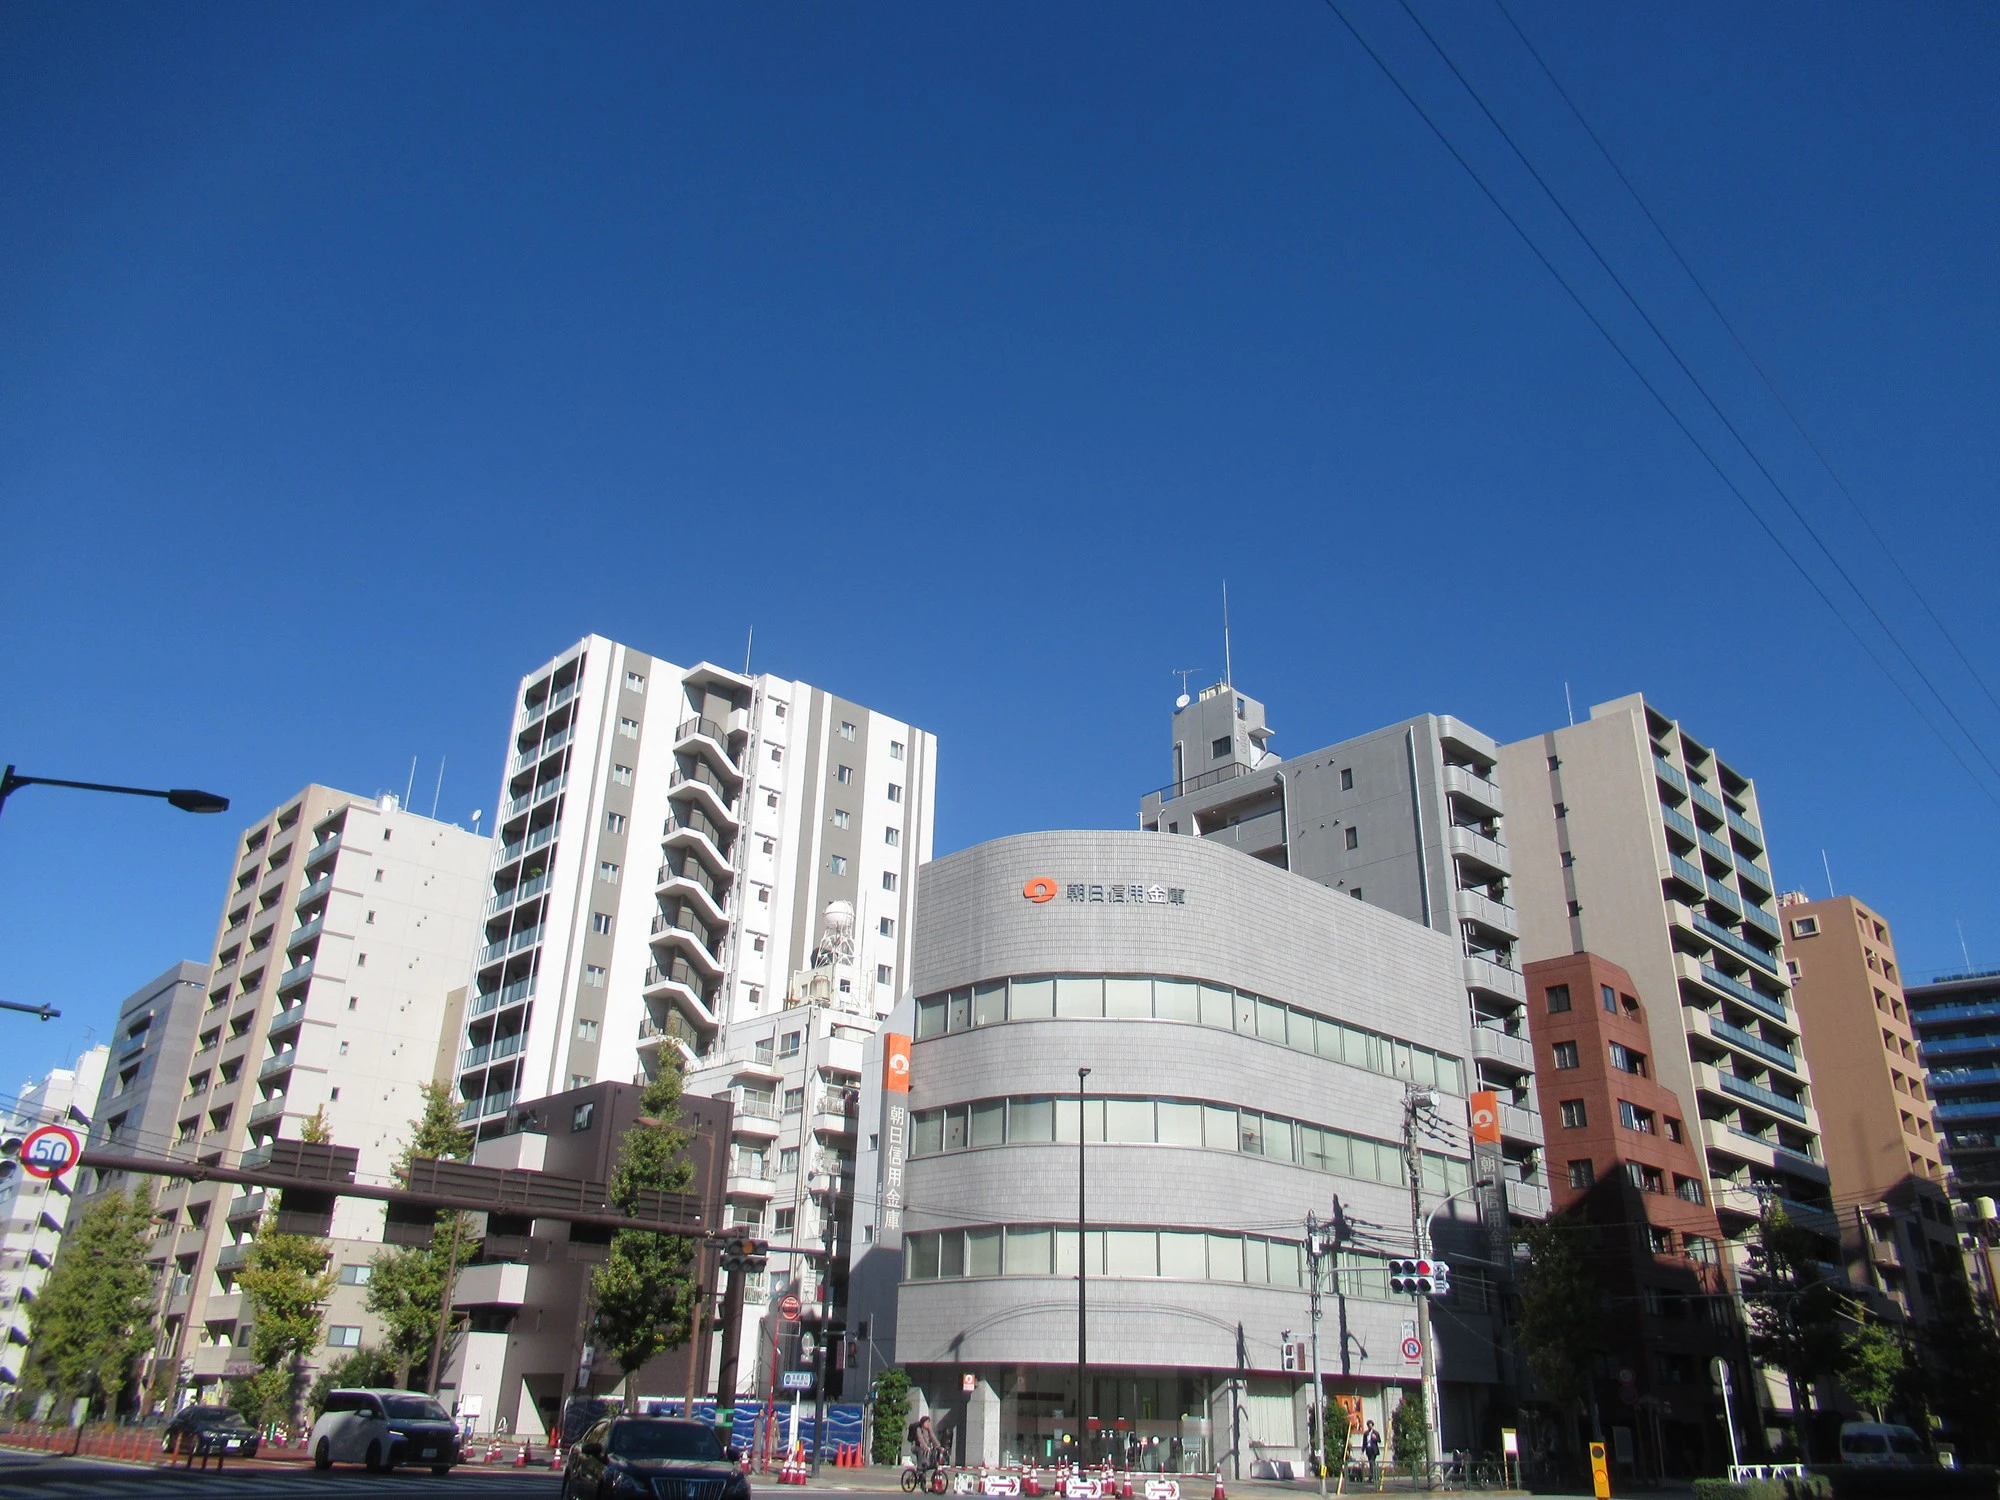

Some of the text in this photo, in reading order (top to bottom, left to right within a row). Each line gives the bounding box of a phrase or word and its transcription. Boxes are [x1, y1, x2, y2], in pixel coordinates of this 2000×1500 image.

[1066, 884, 1186, 905] 朝日信用金庫
[31, 1139, 67, 1166] 50
[884, 1105, 904, 1230] 朝日信用金庫
